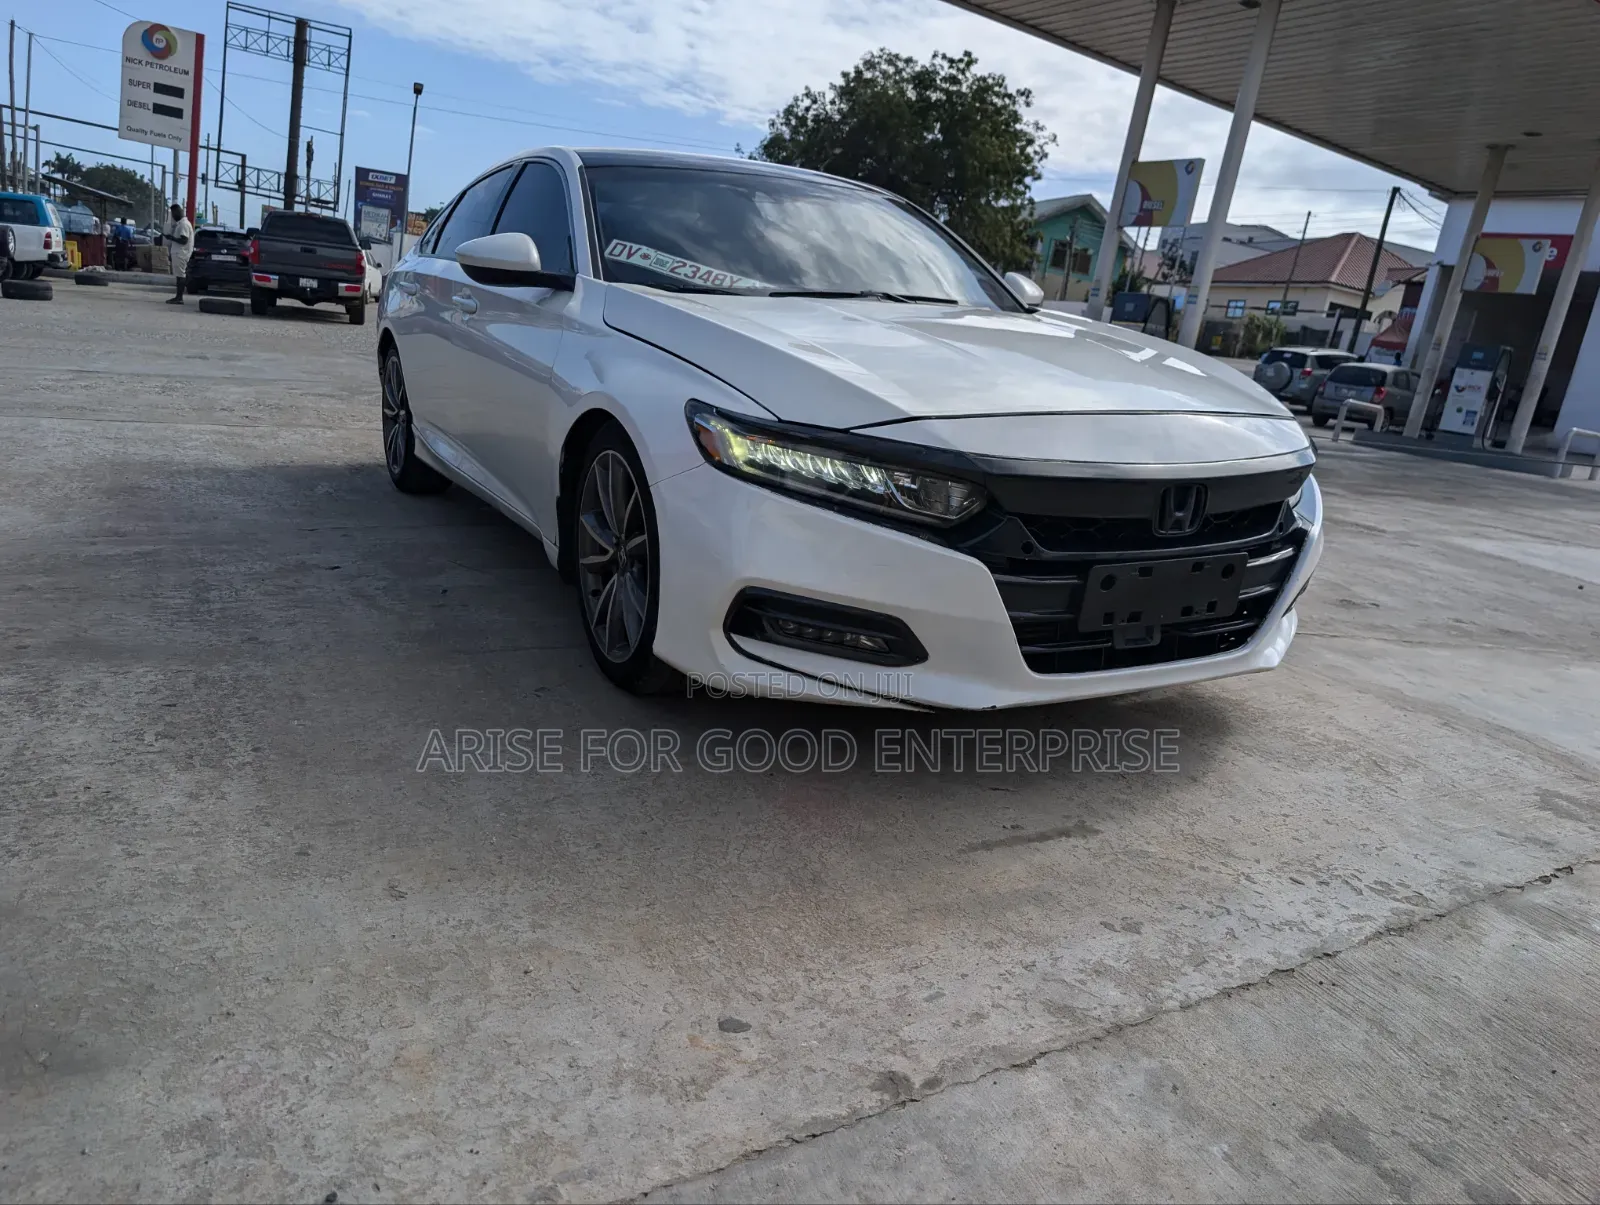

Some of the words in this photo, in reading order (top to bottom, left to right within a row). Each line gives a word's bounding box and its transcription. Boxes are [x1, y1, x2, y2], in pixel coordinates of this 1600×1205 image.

[125, 56, 144, 67] NICK
[145, 60, 190, 76] PETROLEUM
[128, 78, 151, 90] SUPER
[127, 99, 151, 111] DIESEL
[126, 125, 148, 136] Quality
[149, 130, 167, 139] Fuels
[168, 133, 182, 143] Only
[608, 242, 641, 260] DV
[669, 260, 743, 288] 2348Y
